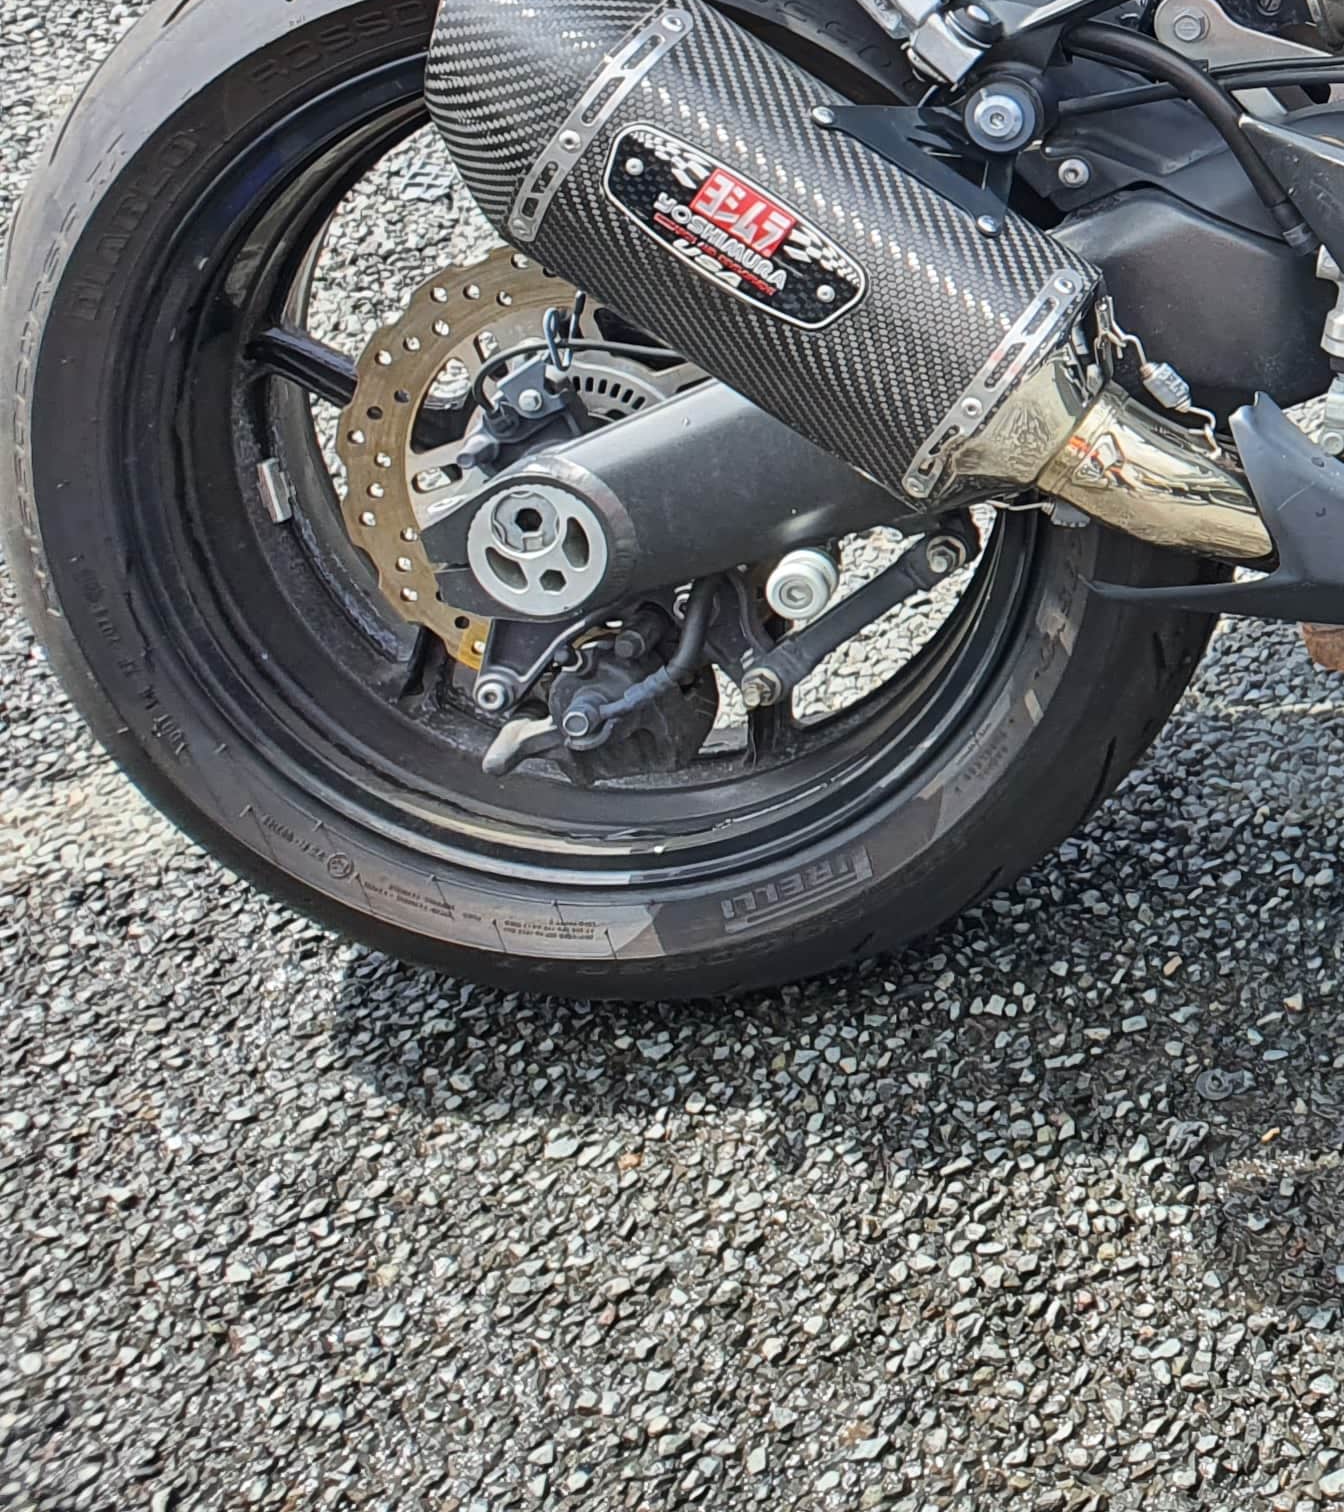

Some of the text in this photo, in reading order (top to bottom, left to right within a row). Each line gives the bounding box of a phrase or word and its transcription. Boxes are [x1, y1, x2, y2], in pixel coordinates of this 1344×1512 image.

[252, 0, 428, 84] ROSSO
[653, 191, 787, 291] YOSHIMURA
[695, 171, 792, 253] ヨシムラ
[672, 238, 743, 288] USA
[721, 845, 873, 934] PIRELLI
